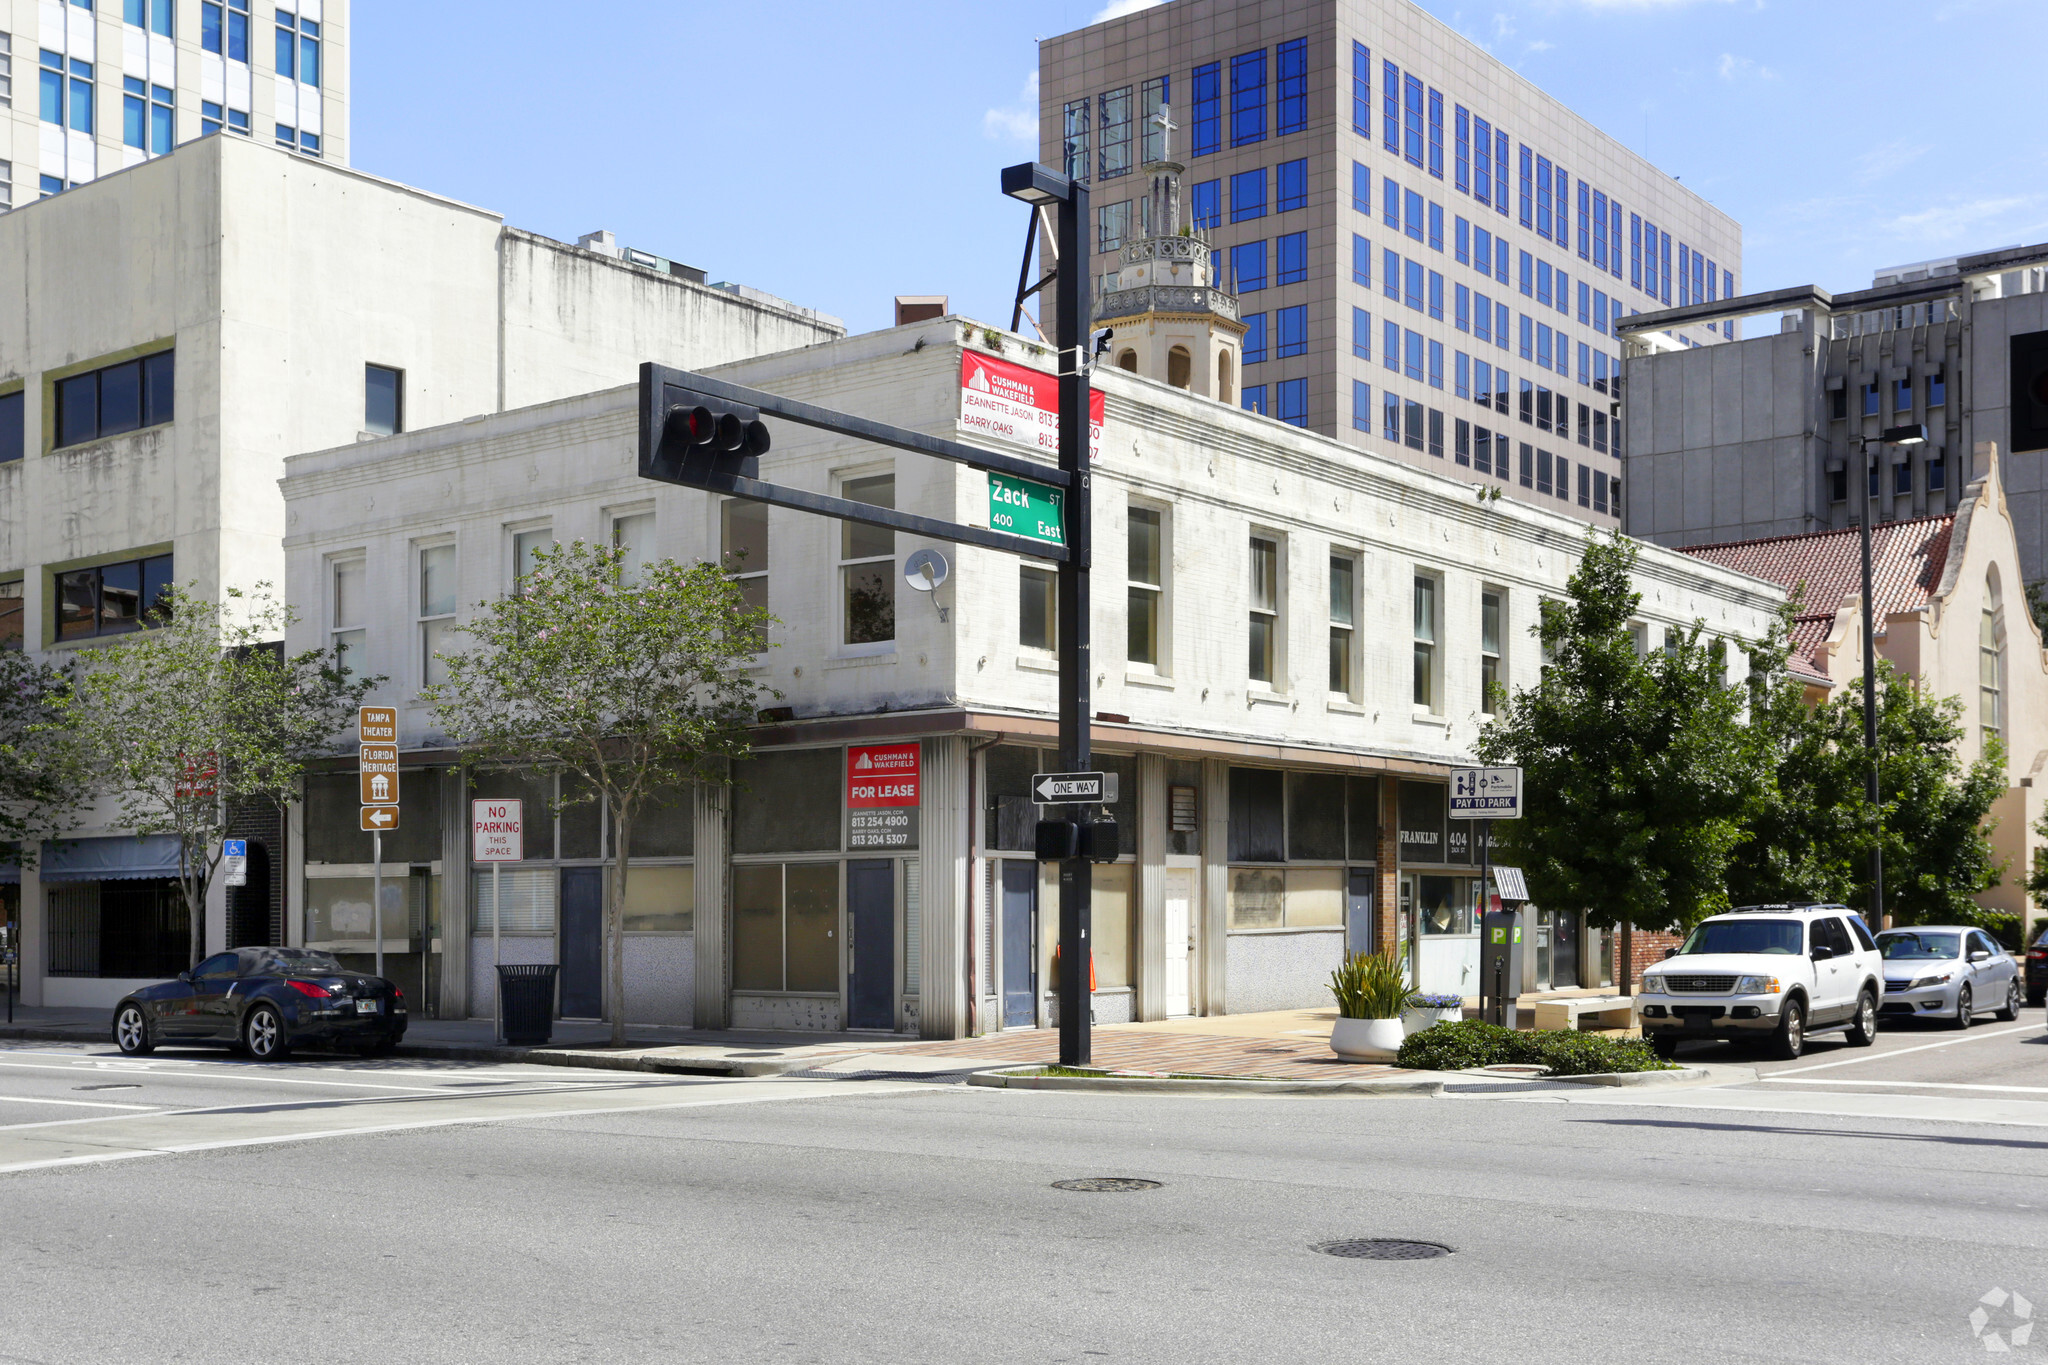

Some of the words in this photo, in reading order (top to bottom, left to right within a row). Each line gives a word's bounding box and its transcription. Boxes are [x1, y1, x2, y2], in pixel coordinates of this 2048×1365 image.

[992, 375, 1028, 392] CUSHMAN
[1029, 387, 1034, 395] &
[992, 385, 1034, 405] WAKEFIELD
[964, 395, 1009, 414] JEANNETTE
[1010, 406, 1033, 420] JASON
[1038, 412, 1052, 427] 813
[964, 414, 991, 430] BARRY
[992, 420, 1013, 434] OAKS
[1038, 433, 1052, 447] 813
[992, 480, 1030, 508] Zack
[1049, 494, 1060, 506] ST
[992, 513, 1013, 527] 400
[1038, 520, 1061, 538] East
[366, 713, 390, 723] TAMPA
[363, 727, 392, 737] THEATER
[363, 749, 394, 760] FLORIDA
[362, 762, 396, 773] HERITAGE
[874, 760, 914, 768] WAKEFIELD
[852, 786, 875, 798] FOR
[878, 785, 915, 797] LEASE
[1054, 783, 1072, 794] ONE
[1076, 782, 1096, 793] WAY
[1456, 799, 1473, 808] PAY
[1475, 798, 1485, 808] TO
[1488, 798, 1511, 807] PARK
[488, 807, 506, 818] NO
[476, 822, 519, 833] PARKING
[852, 817, 865, 827] 813
[867, 817, 883, 826] 254
[885, 816, 908, 826] 4900
[852, 835, 865, 845] 813
[867, 835, 884, 844] 204
[886, 834, 908, 844] 5307
[1400, 831, 1438, 844] FRANKLIN
[1450, 832, 1467, 845] 404
[1494, 928, 1504, 943] P
[1514, 928, 1520, 943] P
